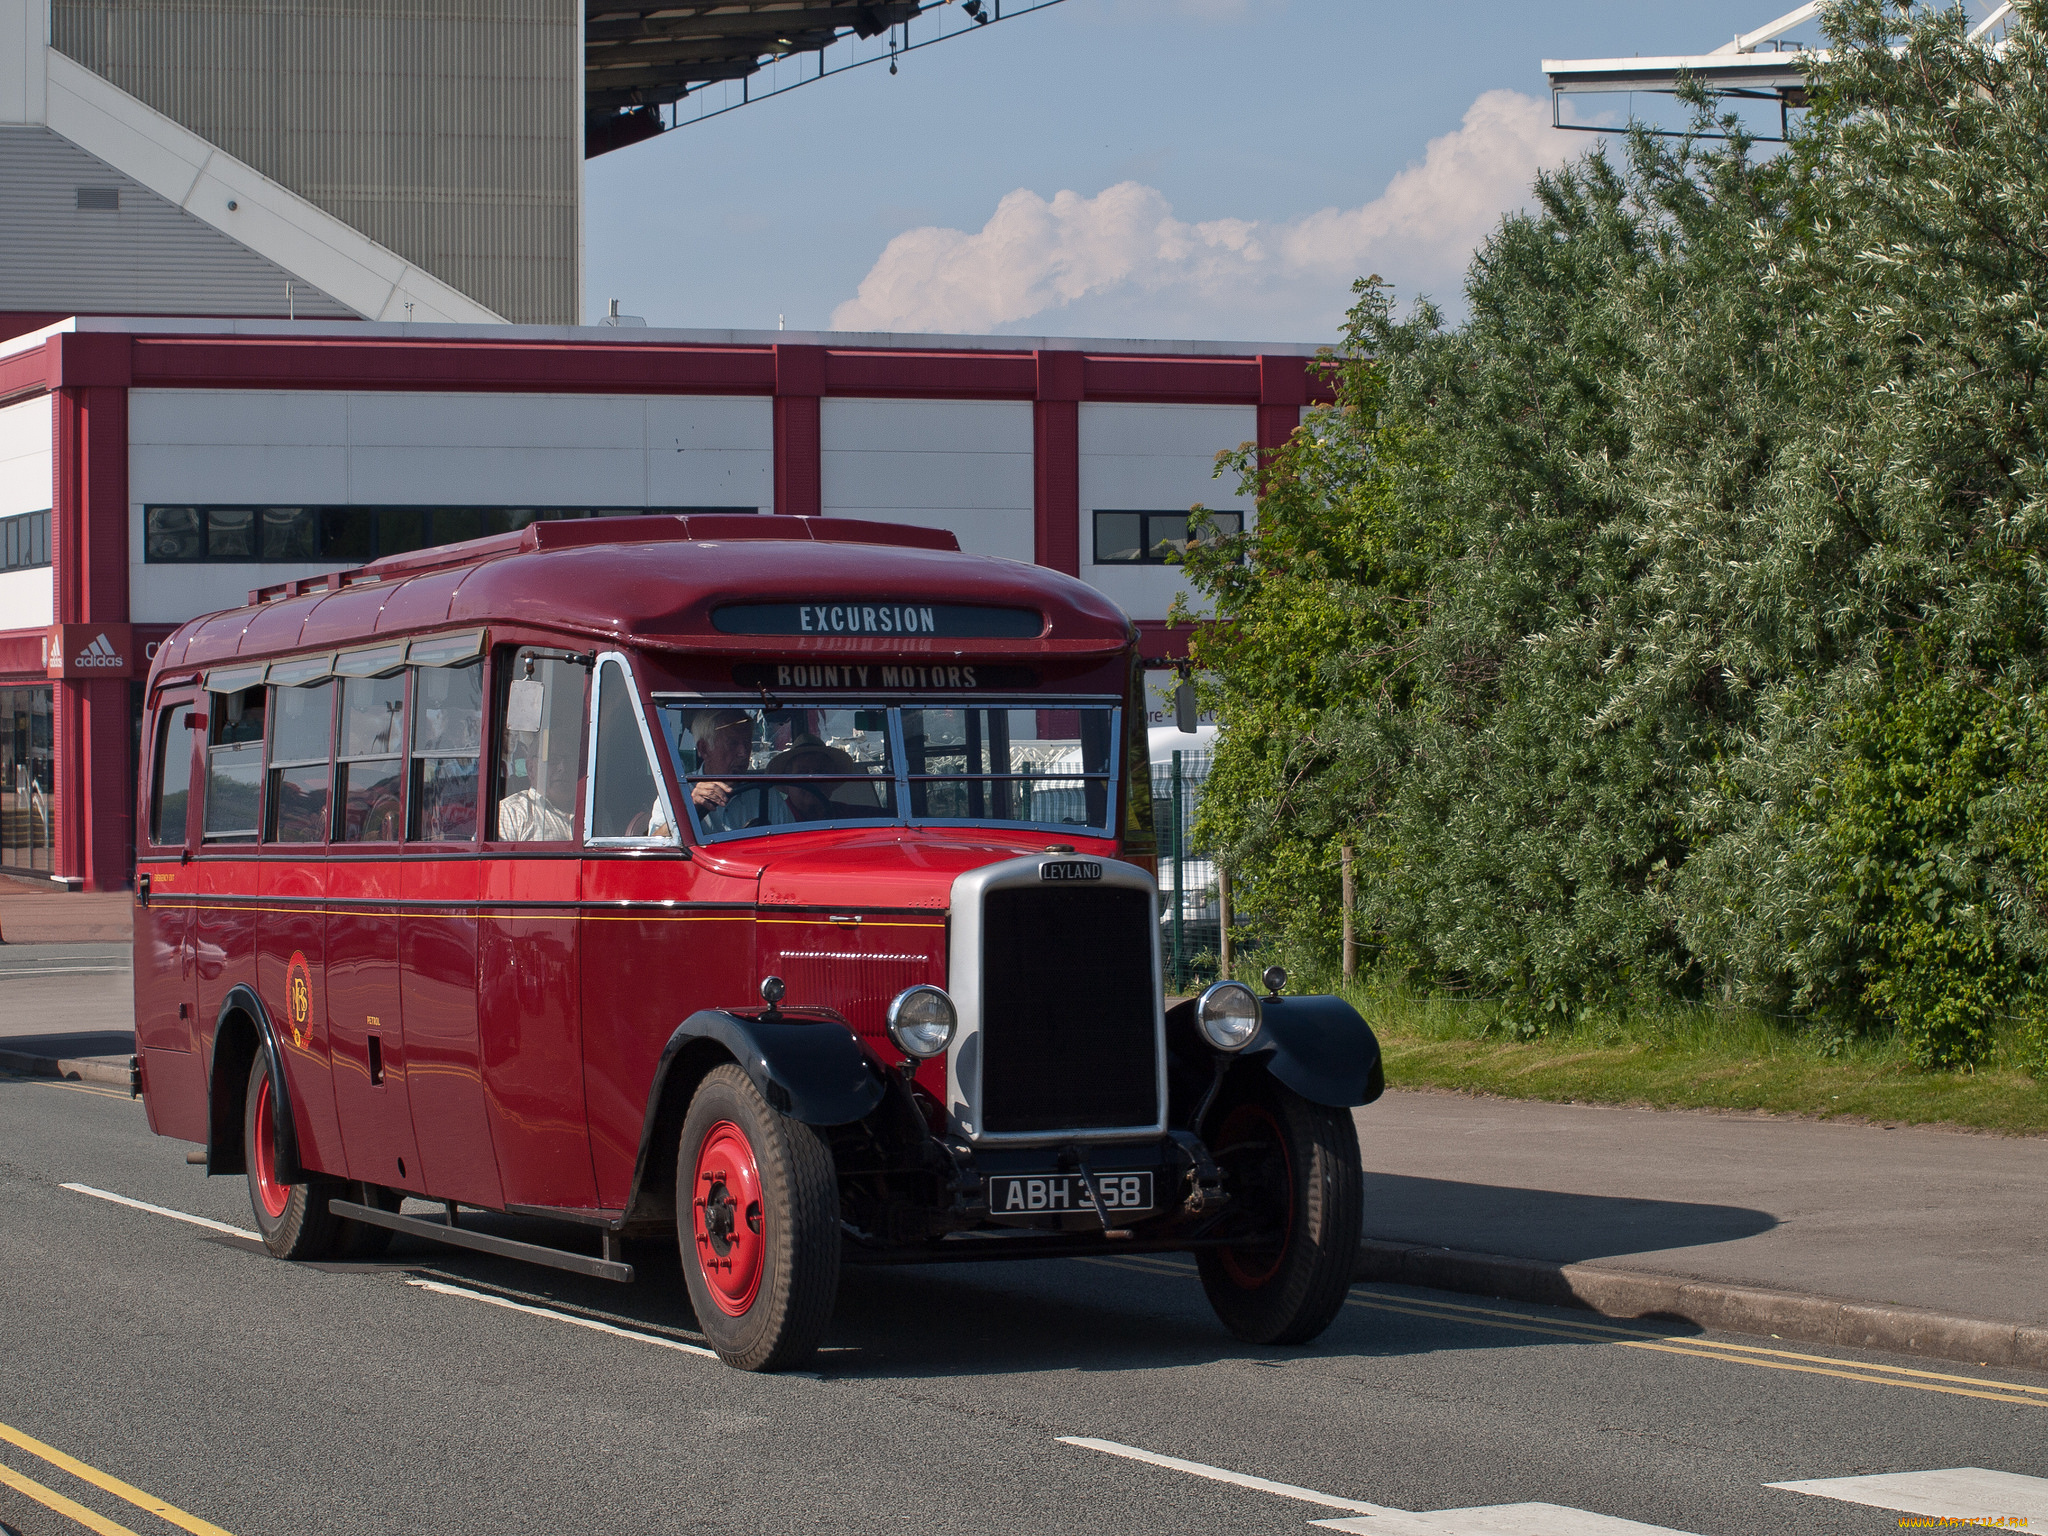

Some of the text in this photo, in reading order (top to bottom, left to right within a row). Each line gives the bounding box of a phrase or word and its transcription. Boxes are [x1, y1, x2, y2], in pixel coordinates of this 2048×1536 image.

[800, 606, 935, 632] EXCURSION
[74, 654, 124, 667] adidas
[777, 665, 977, 688] BOUNTY MOTORS
[1043, 863, 1101, 879] LEYLAND
[366, 1015, 381, 1026] PETROL
[1005, 1179, 1069, 1210] ABH
